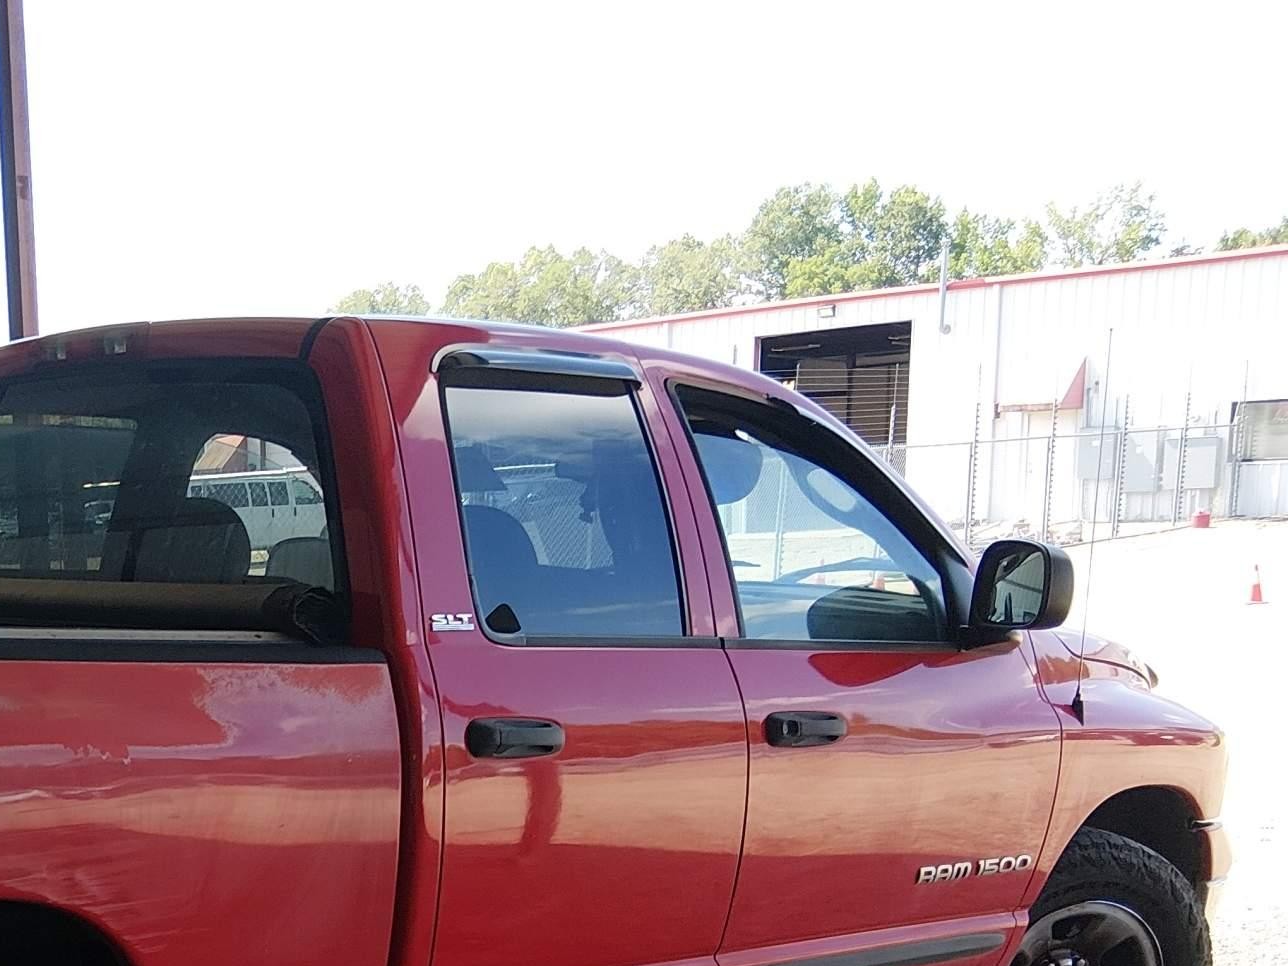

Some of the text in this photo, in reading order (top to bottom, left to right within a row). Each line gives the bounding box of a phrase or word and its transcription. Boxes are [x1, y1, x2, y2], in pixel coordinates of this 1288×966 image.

[431, 613, 473, 625] SLT
[916, 854, 1032, 885] RAM 1500
